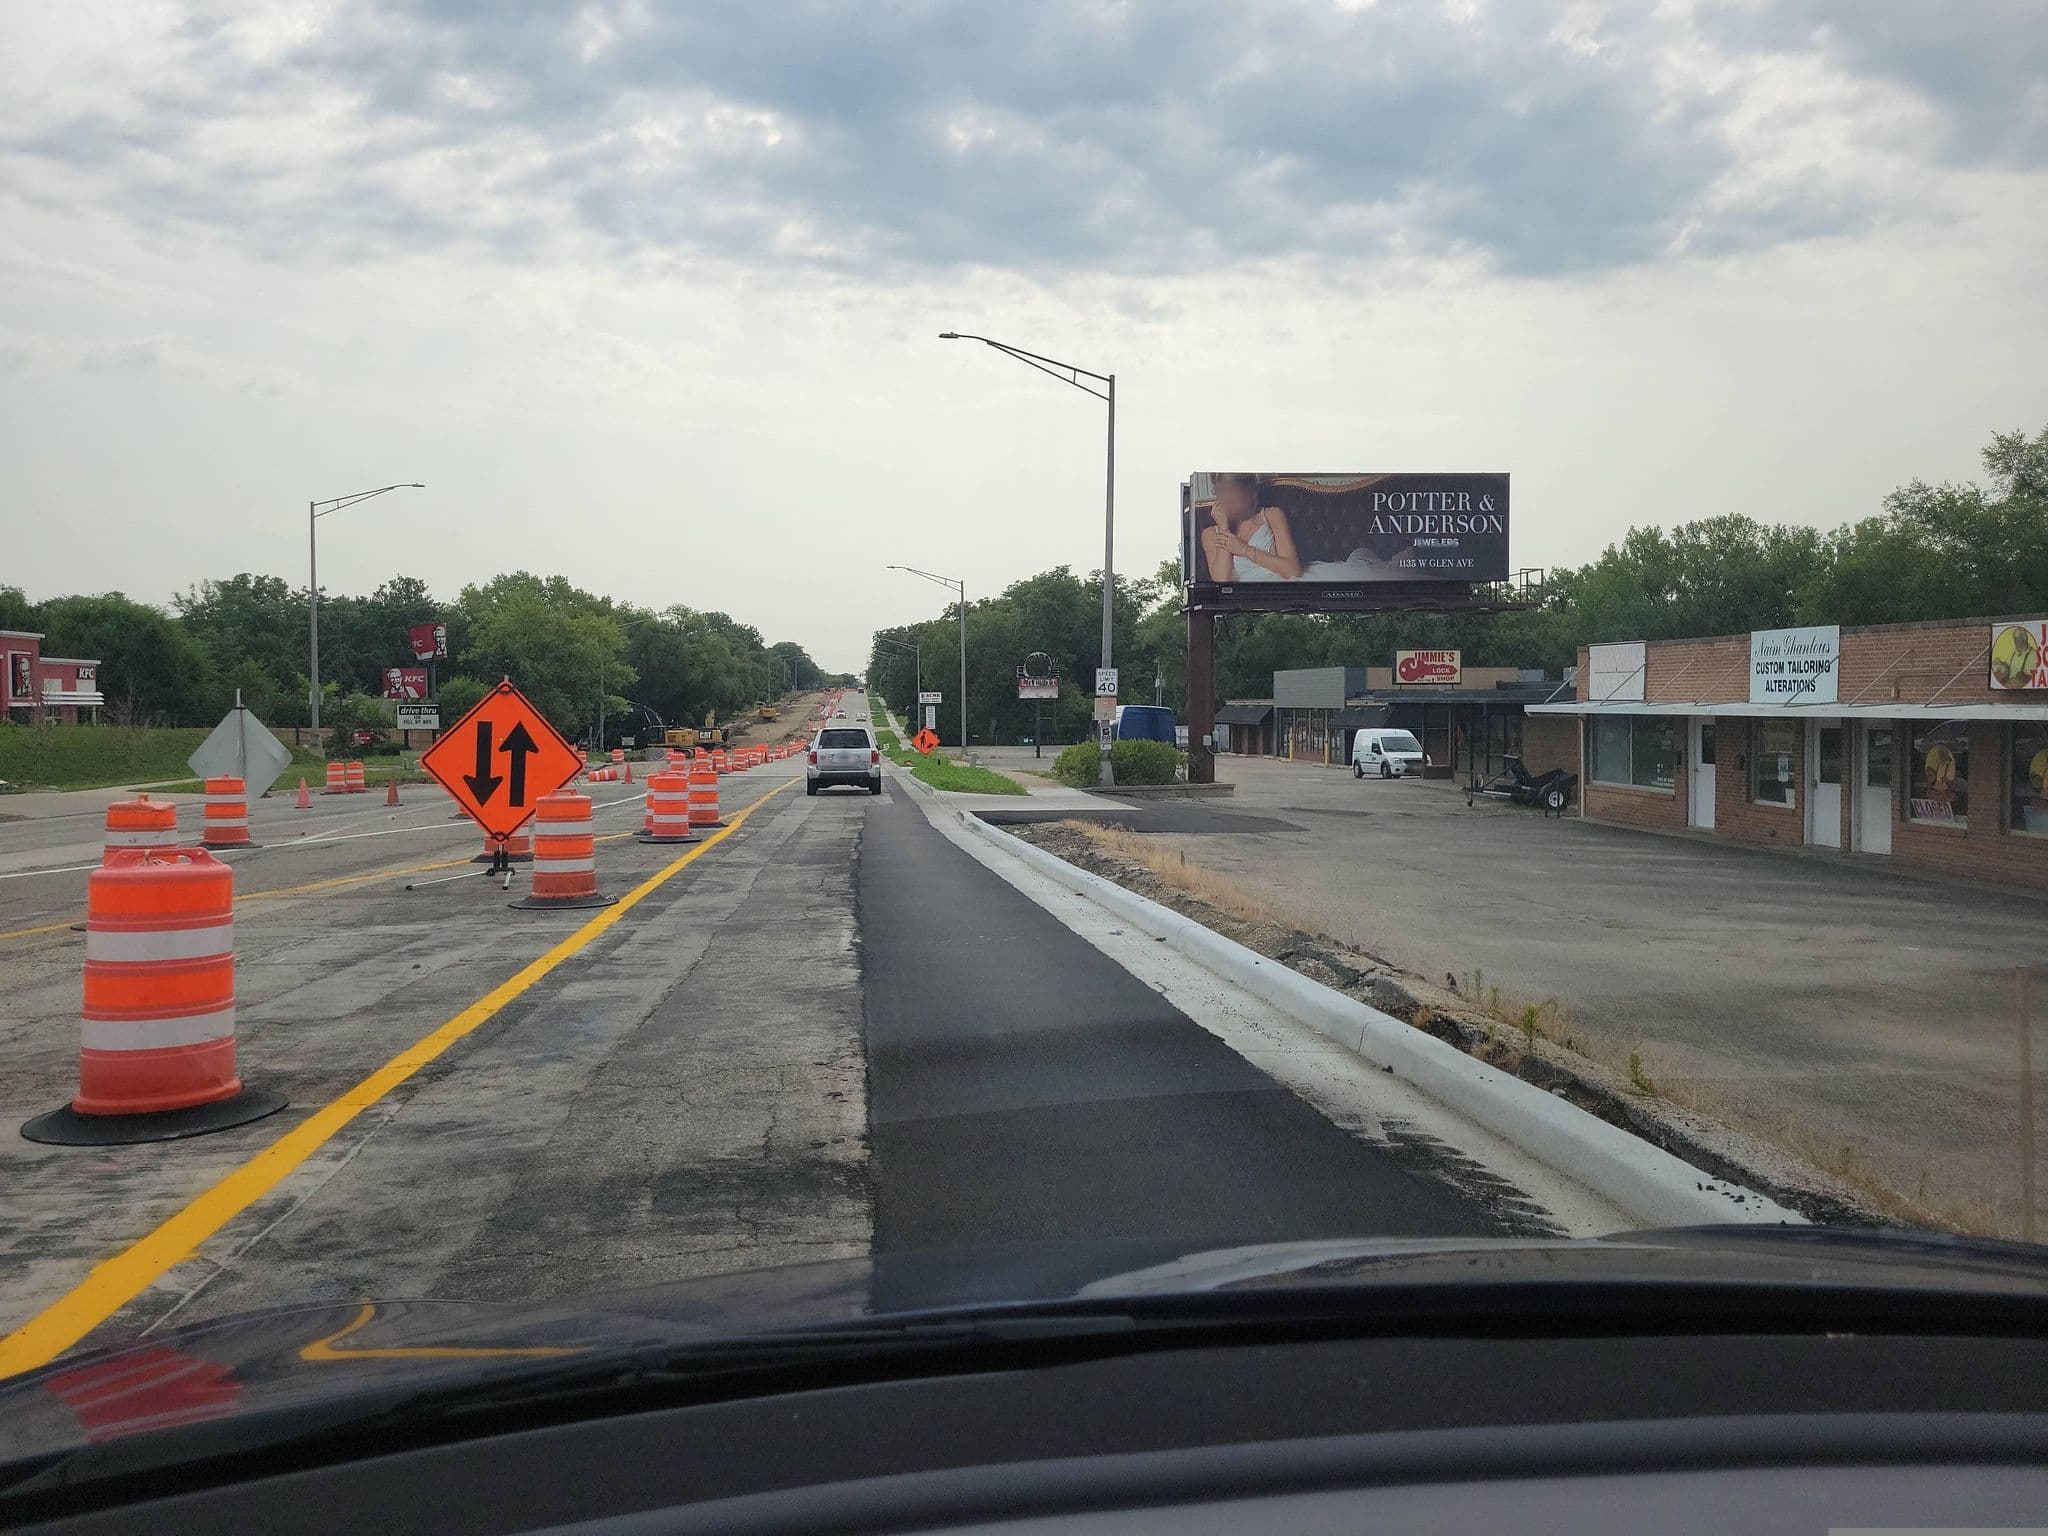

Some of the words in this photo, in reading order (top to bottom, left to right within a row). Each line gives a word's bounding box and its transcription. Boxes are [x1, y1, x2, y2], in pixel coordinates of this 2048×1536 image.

[1371, 492, 1472, 512] POTTER
[1479, 493, 1496, 512] &
[1368, 514, 1504, 534] ANDERSON
[1413, 538, 1460, 547] JEWELERS
[1400, 559, 1416, 568] 1135
[1419, 559, 1429, 568] W
[1429, 559, 1454, 568] GLEN
[1456, 559, 1474, 568] AVE
[1410, 651, 1455, 669] JIMMIE'S
[79, 668, 94, 678] KFC
[1755, 661, 1785, 675] CUSTOM
[1787, 660, 1831, 674] TAILORING
[1098, 682, 1116, 693] 40
[1765, 679, 1816, 693] ALTERATIONS
[401, 706, 420, 714] drive
[421, 706, 437, 714] thru
[700, 731, 711, 739] CAT
